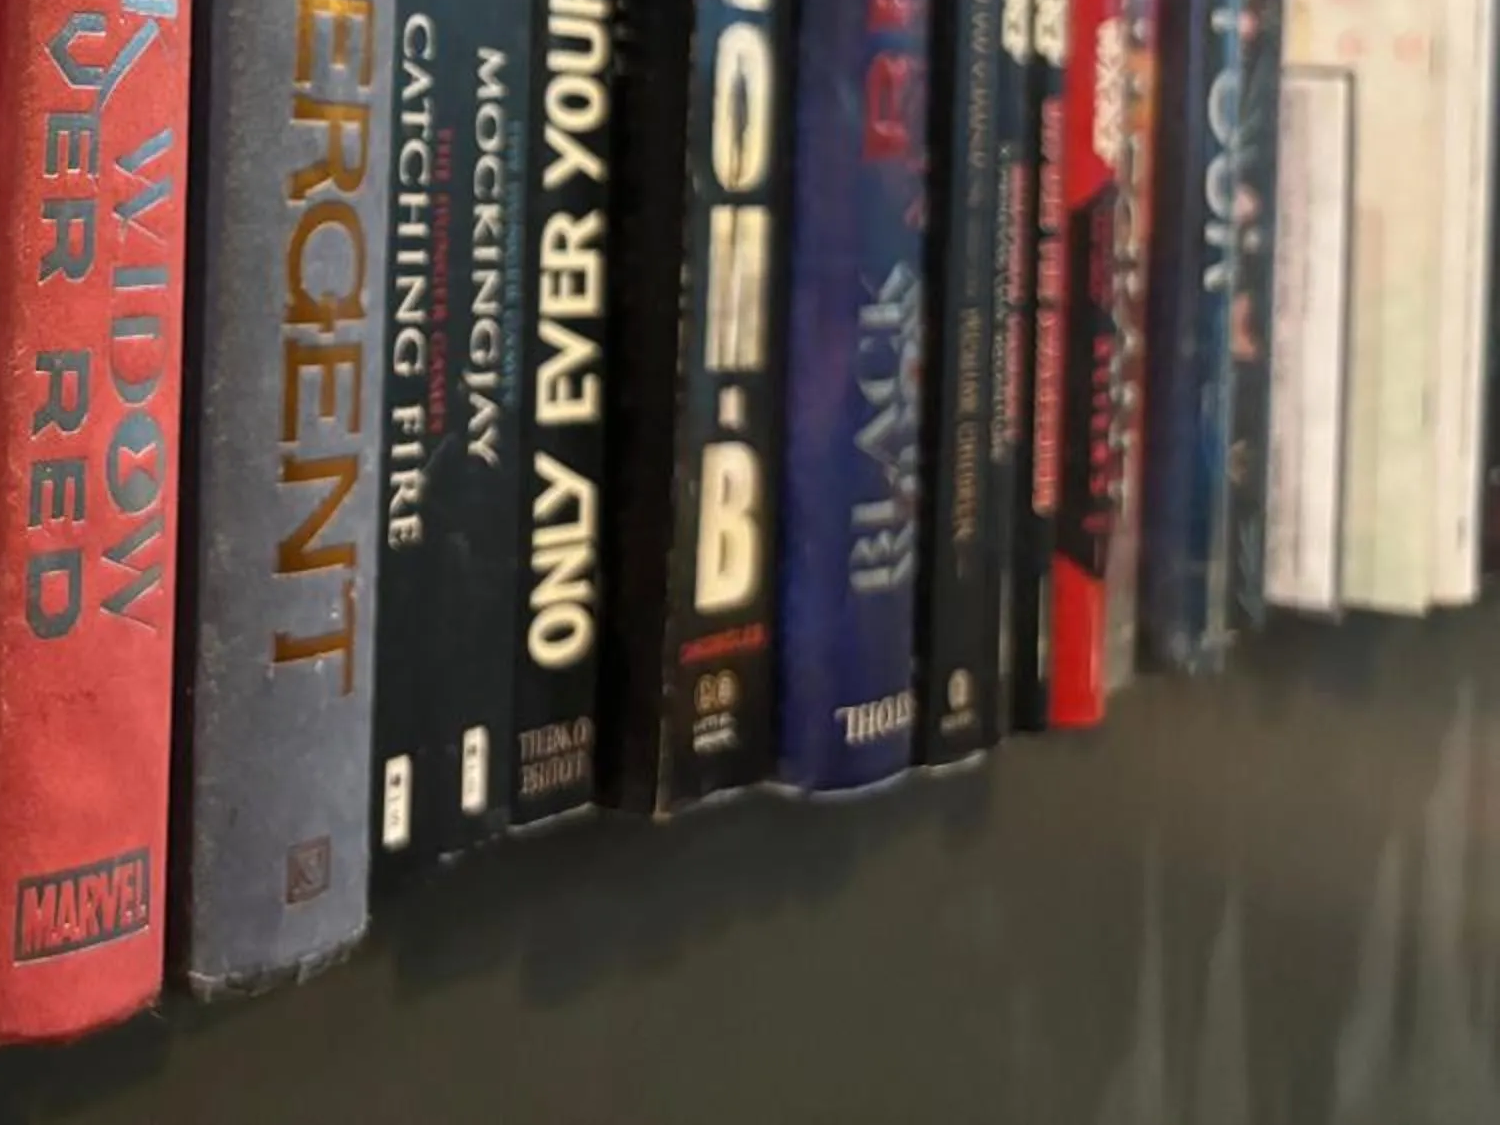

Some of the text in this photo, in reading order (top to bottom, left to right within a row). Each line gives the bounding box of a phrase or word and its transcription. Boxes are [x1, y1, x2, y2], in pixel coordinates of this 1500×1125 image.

[100, 129, 175, 634] WIDOW
[387, 13, 435, 550] CATCHING FIRE
[462, 46, 508, 468] MOCKINGJAY
[536, 211, 604, 425] EVER
[25, 350, 92, 639] RED
[527, 453, 593, 668] ONLY
[16, 855, 147, 960] MARVEL
